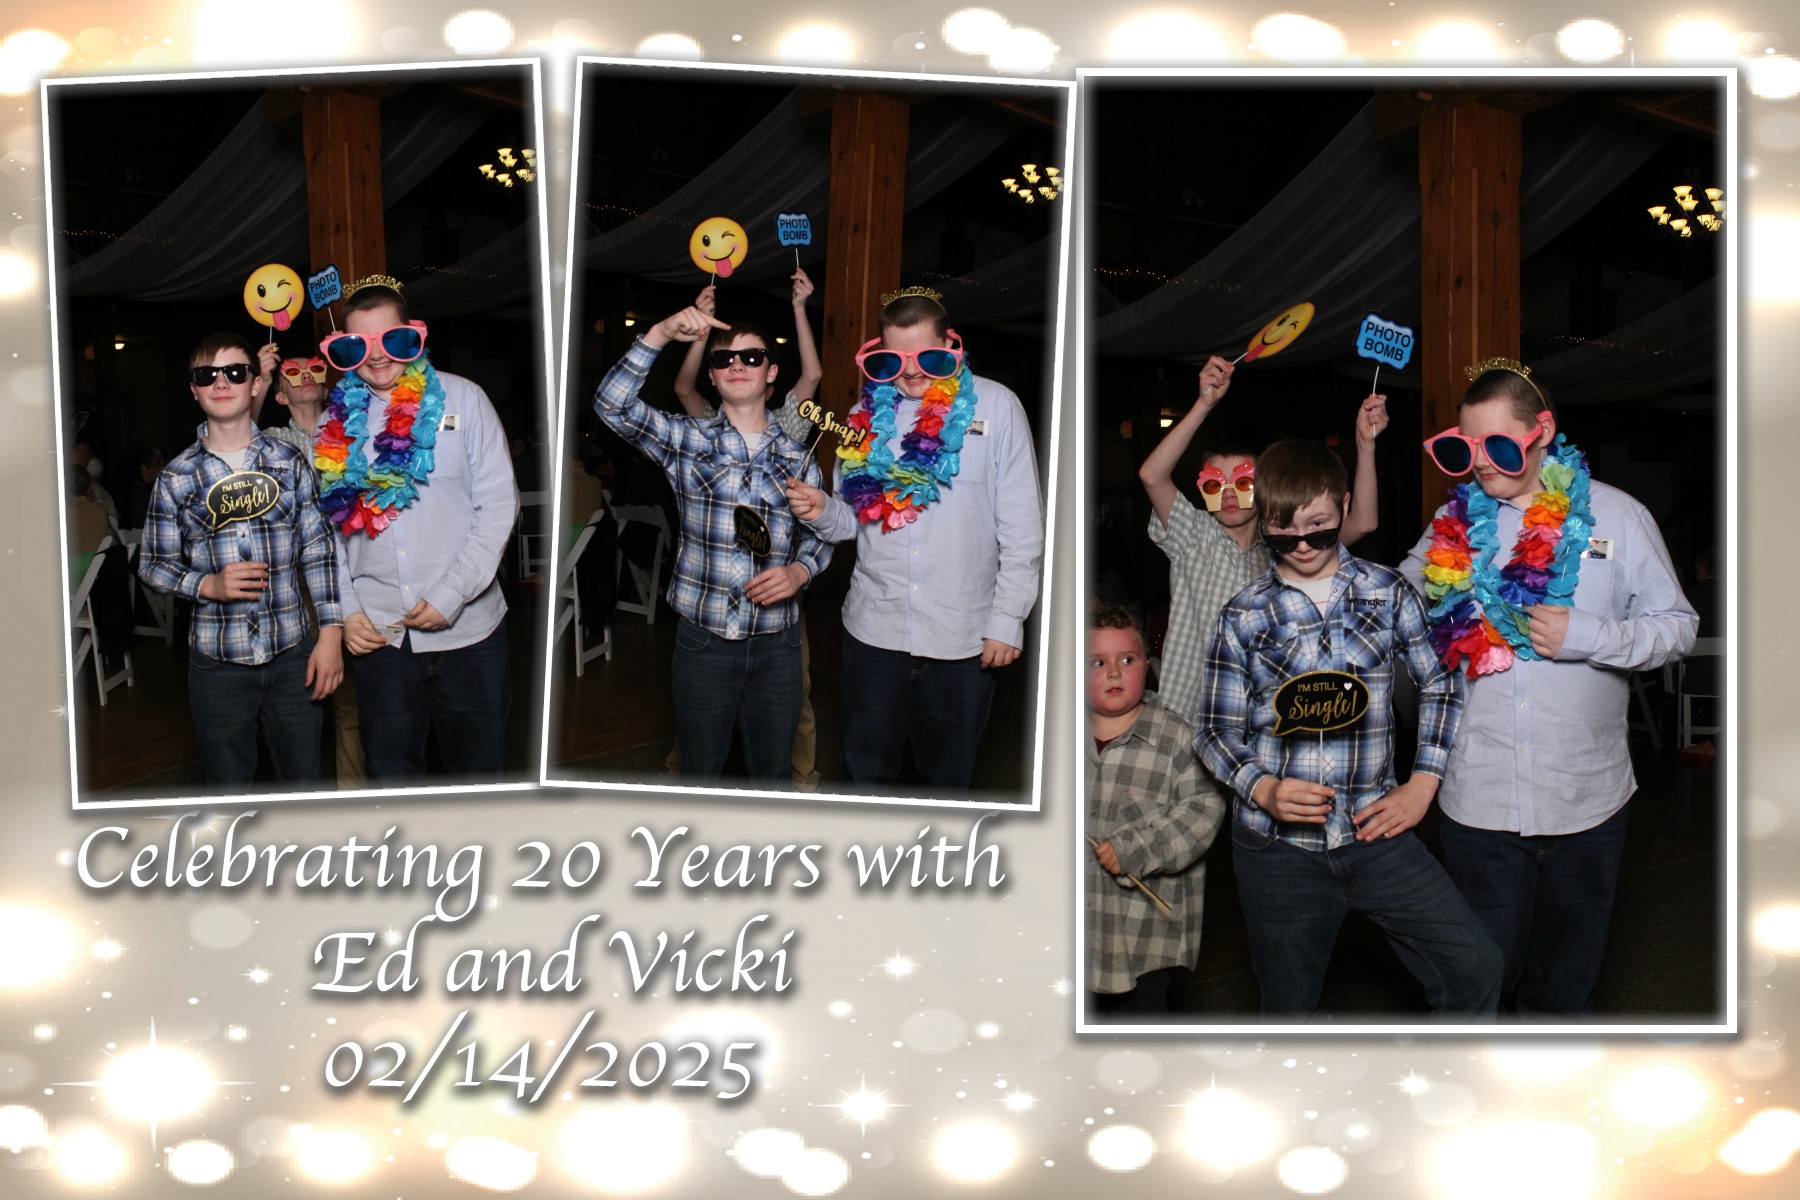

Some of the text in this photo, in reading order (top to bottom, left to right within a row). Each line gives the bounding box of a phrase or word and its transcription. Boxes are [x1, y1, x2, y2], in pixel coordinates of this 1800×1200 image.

[780, 219, 808, 229] PHOTO
[783, 230, 808, 241] BOMB
[310, 271, 337, 293] PHOTO
[314, 284, 338, 303] BOMB
[1364, 321, 1411, 348] PHOTO
[1363, 337, 1405, 362] BOMB
[799, 400, 867, 447] Oh Snap!
[221, 479, 253, 493] I'M STILL
[220, 483, 270, 515] Single!
[1346, 596, 1388, 610] Wrangler
[1297, 681, 1339, 693] I'M STILL
[1287, 690, 1358, 725] Single!
